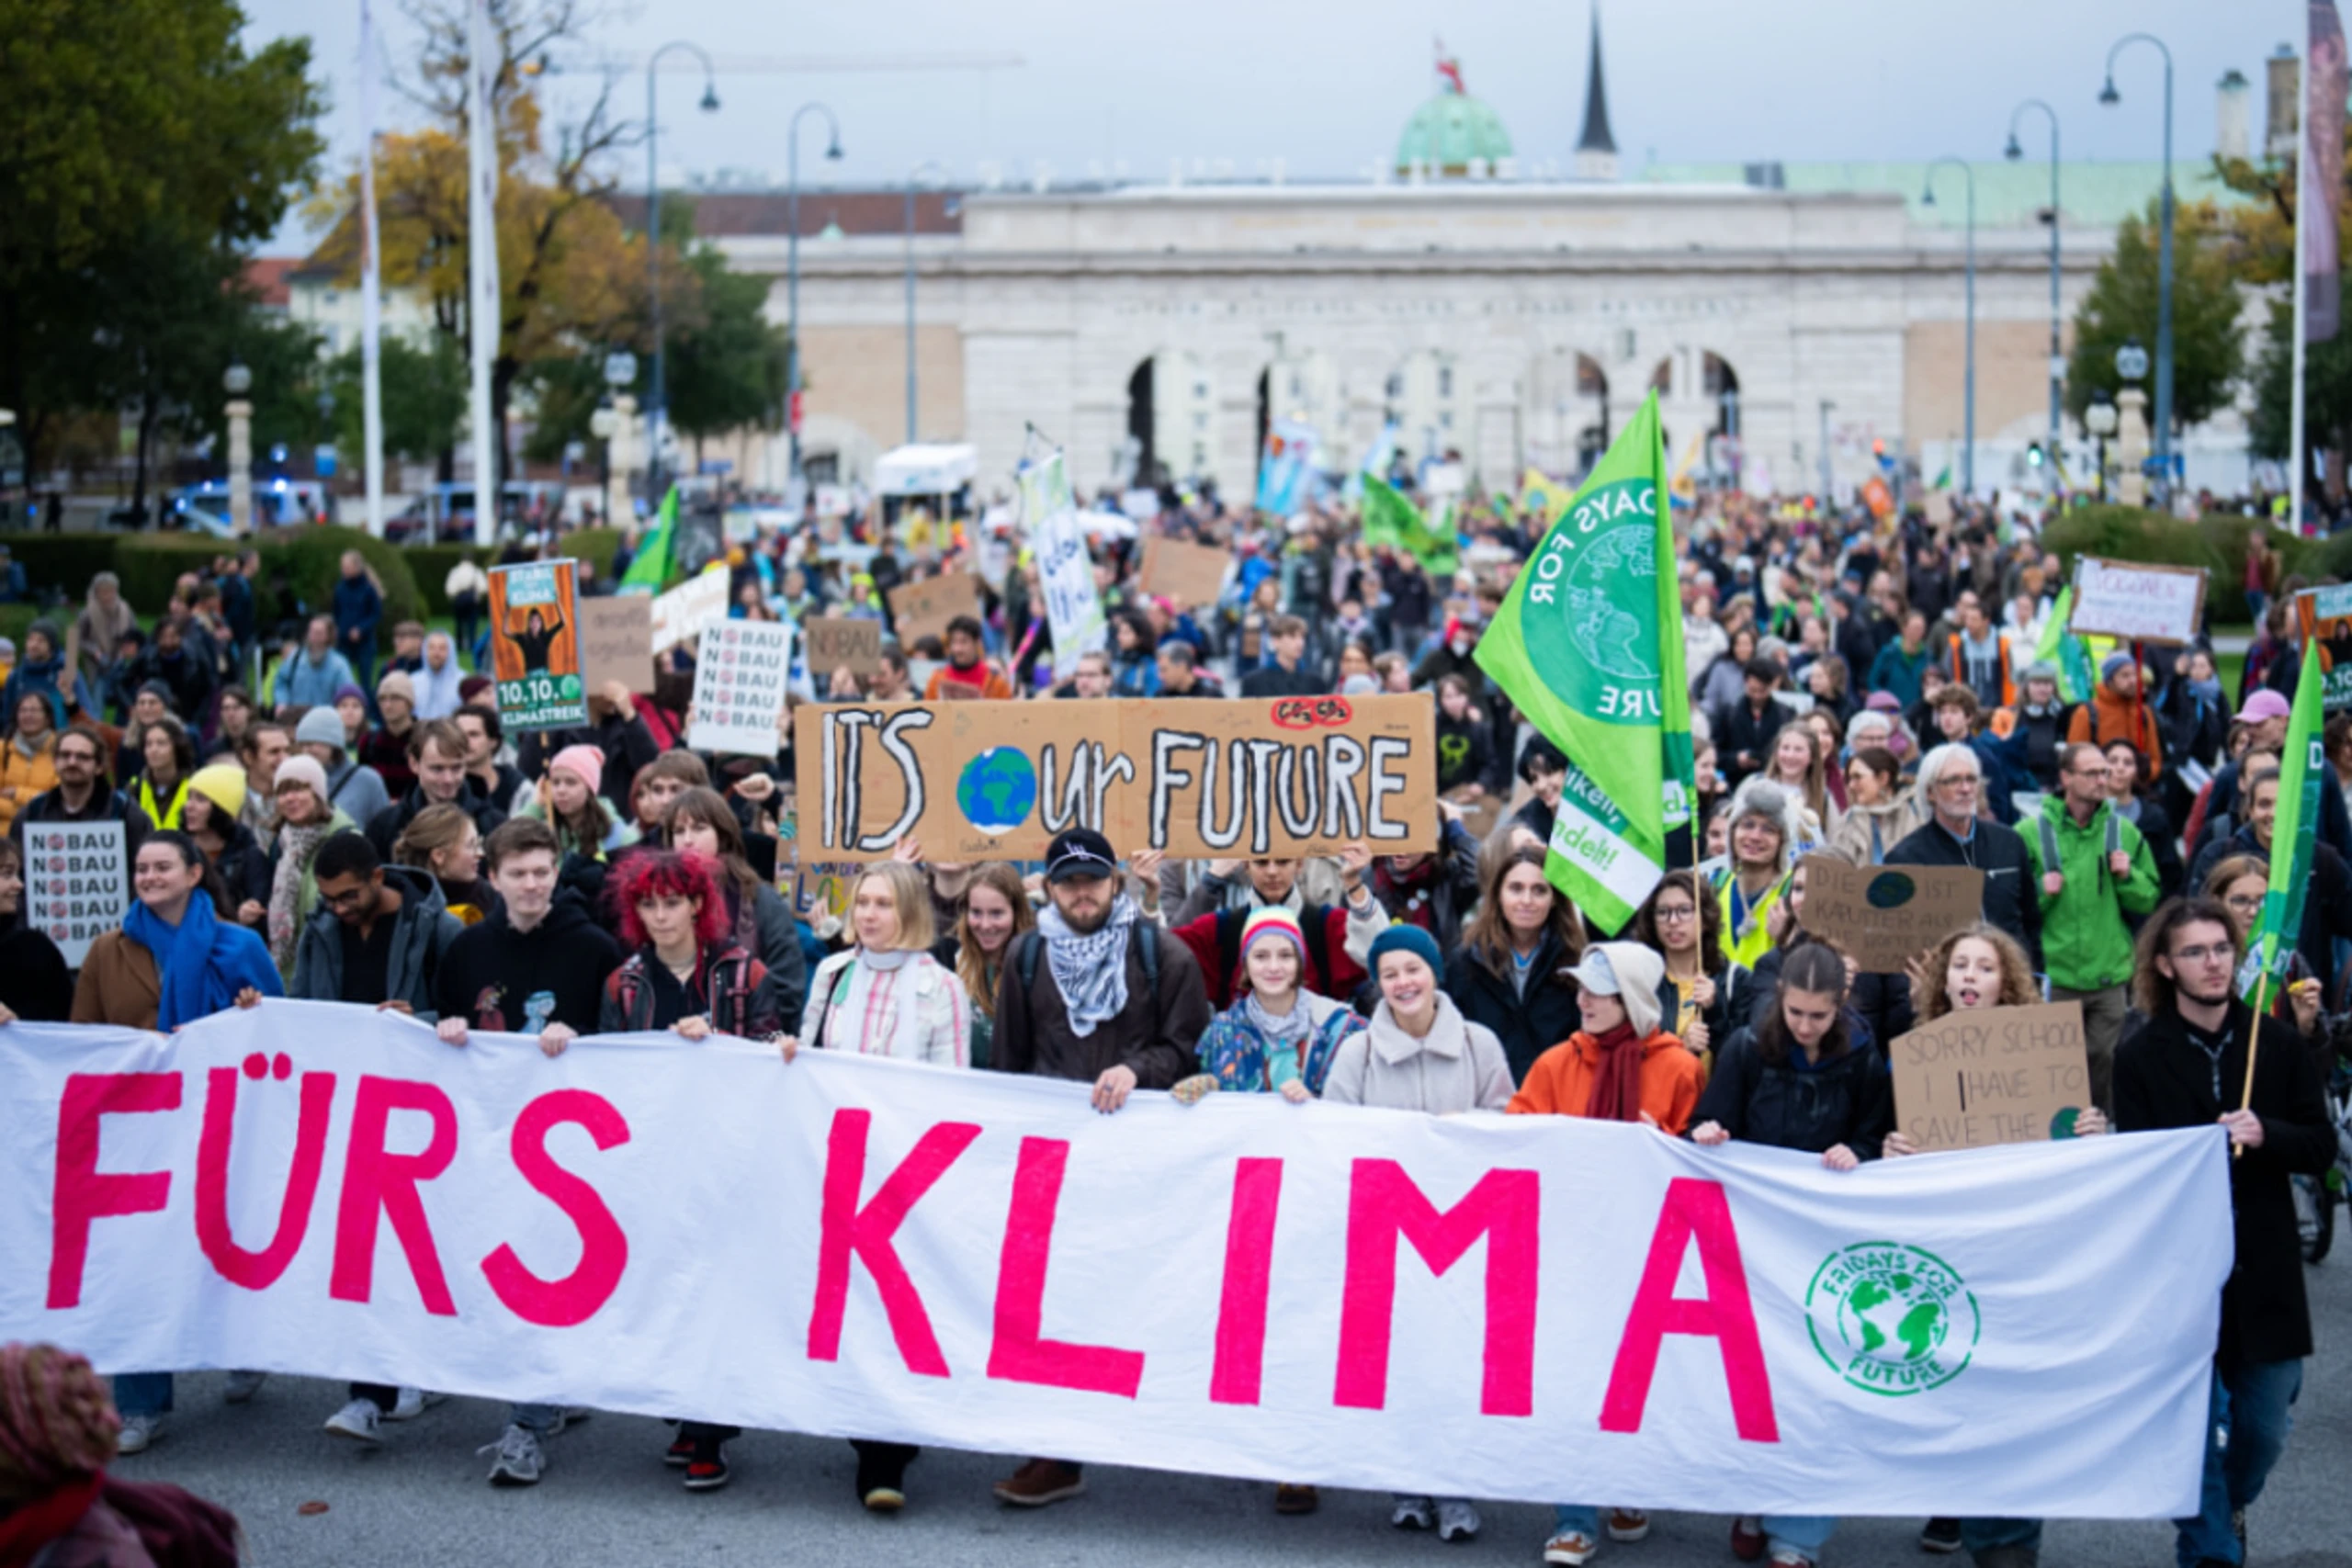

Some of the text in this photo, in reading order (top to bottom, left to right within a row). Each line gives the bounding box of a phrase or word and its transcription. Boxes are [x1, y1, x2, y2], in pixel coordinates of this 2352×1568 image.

[499, 679, 560, 705] 10.10.
[821, 707, 934, 852] IT'S
[1148, 728, 1411, 854] FUTURE
[1815, 864, 1959, 900] DIE IST
[1905, 1021, 2084, 1066] SORRY SCHOOL
[1967, 1067, 2032, 1104] HAVE
[2046, 1064, 2086, 1094] TO
[1909, 1112, 2038, 1148] SAVE THE
[46, 1052, 1779, 1442] FÜRS KLIMA
[1822, 1251, 1959, 1299] FRIDAYS FOR
[1848, 1353, 1946, 1386] FUTURE
